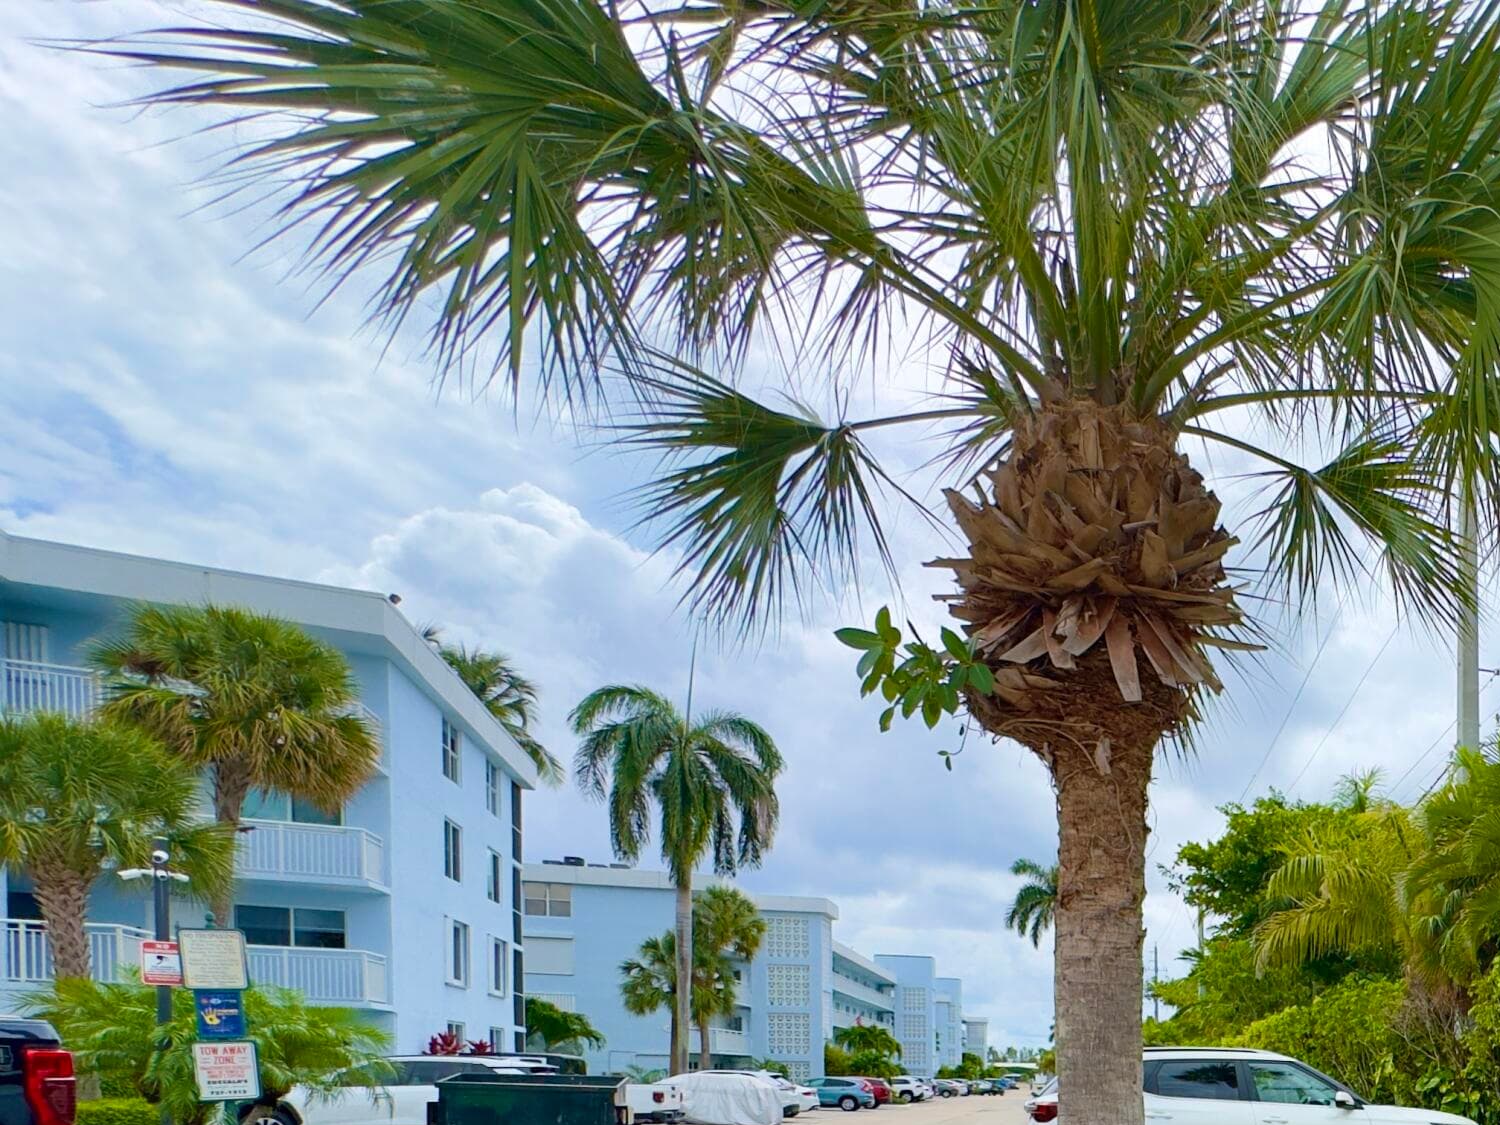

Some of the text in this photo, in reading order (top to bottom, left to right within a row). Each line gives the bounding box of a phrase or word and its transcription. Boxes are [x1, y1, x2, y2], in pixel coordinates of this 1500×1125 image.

[200, 1046, 247, 1055] TOW AWAY
[214, 1056, 236, 1065] ZONE
